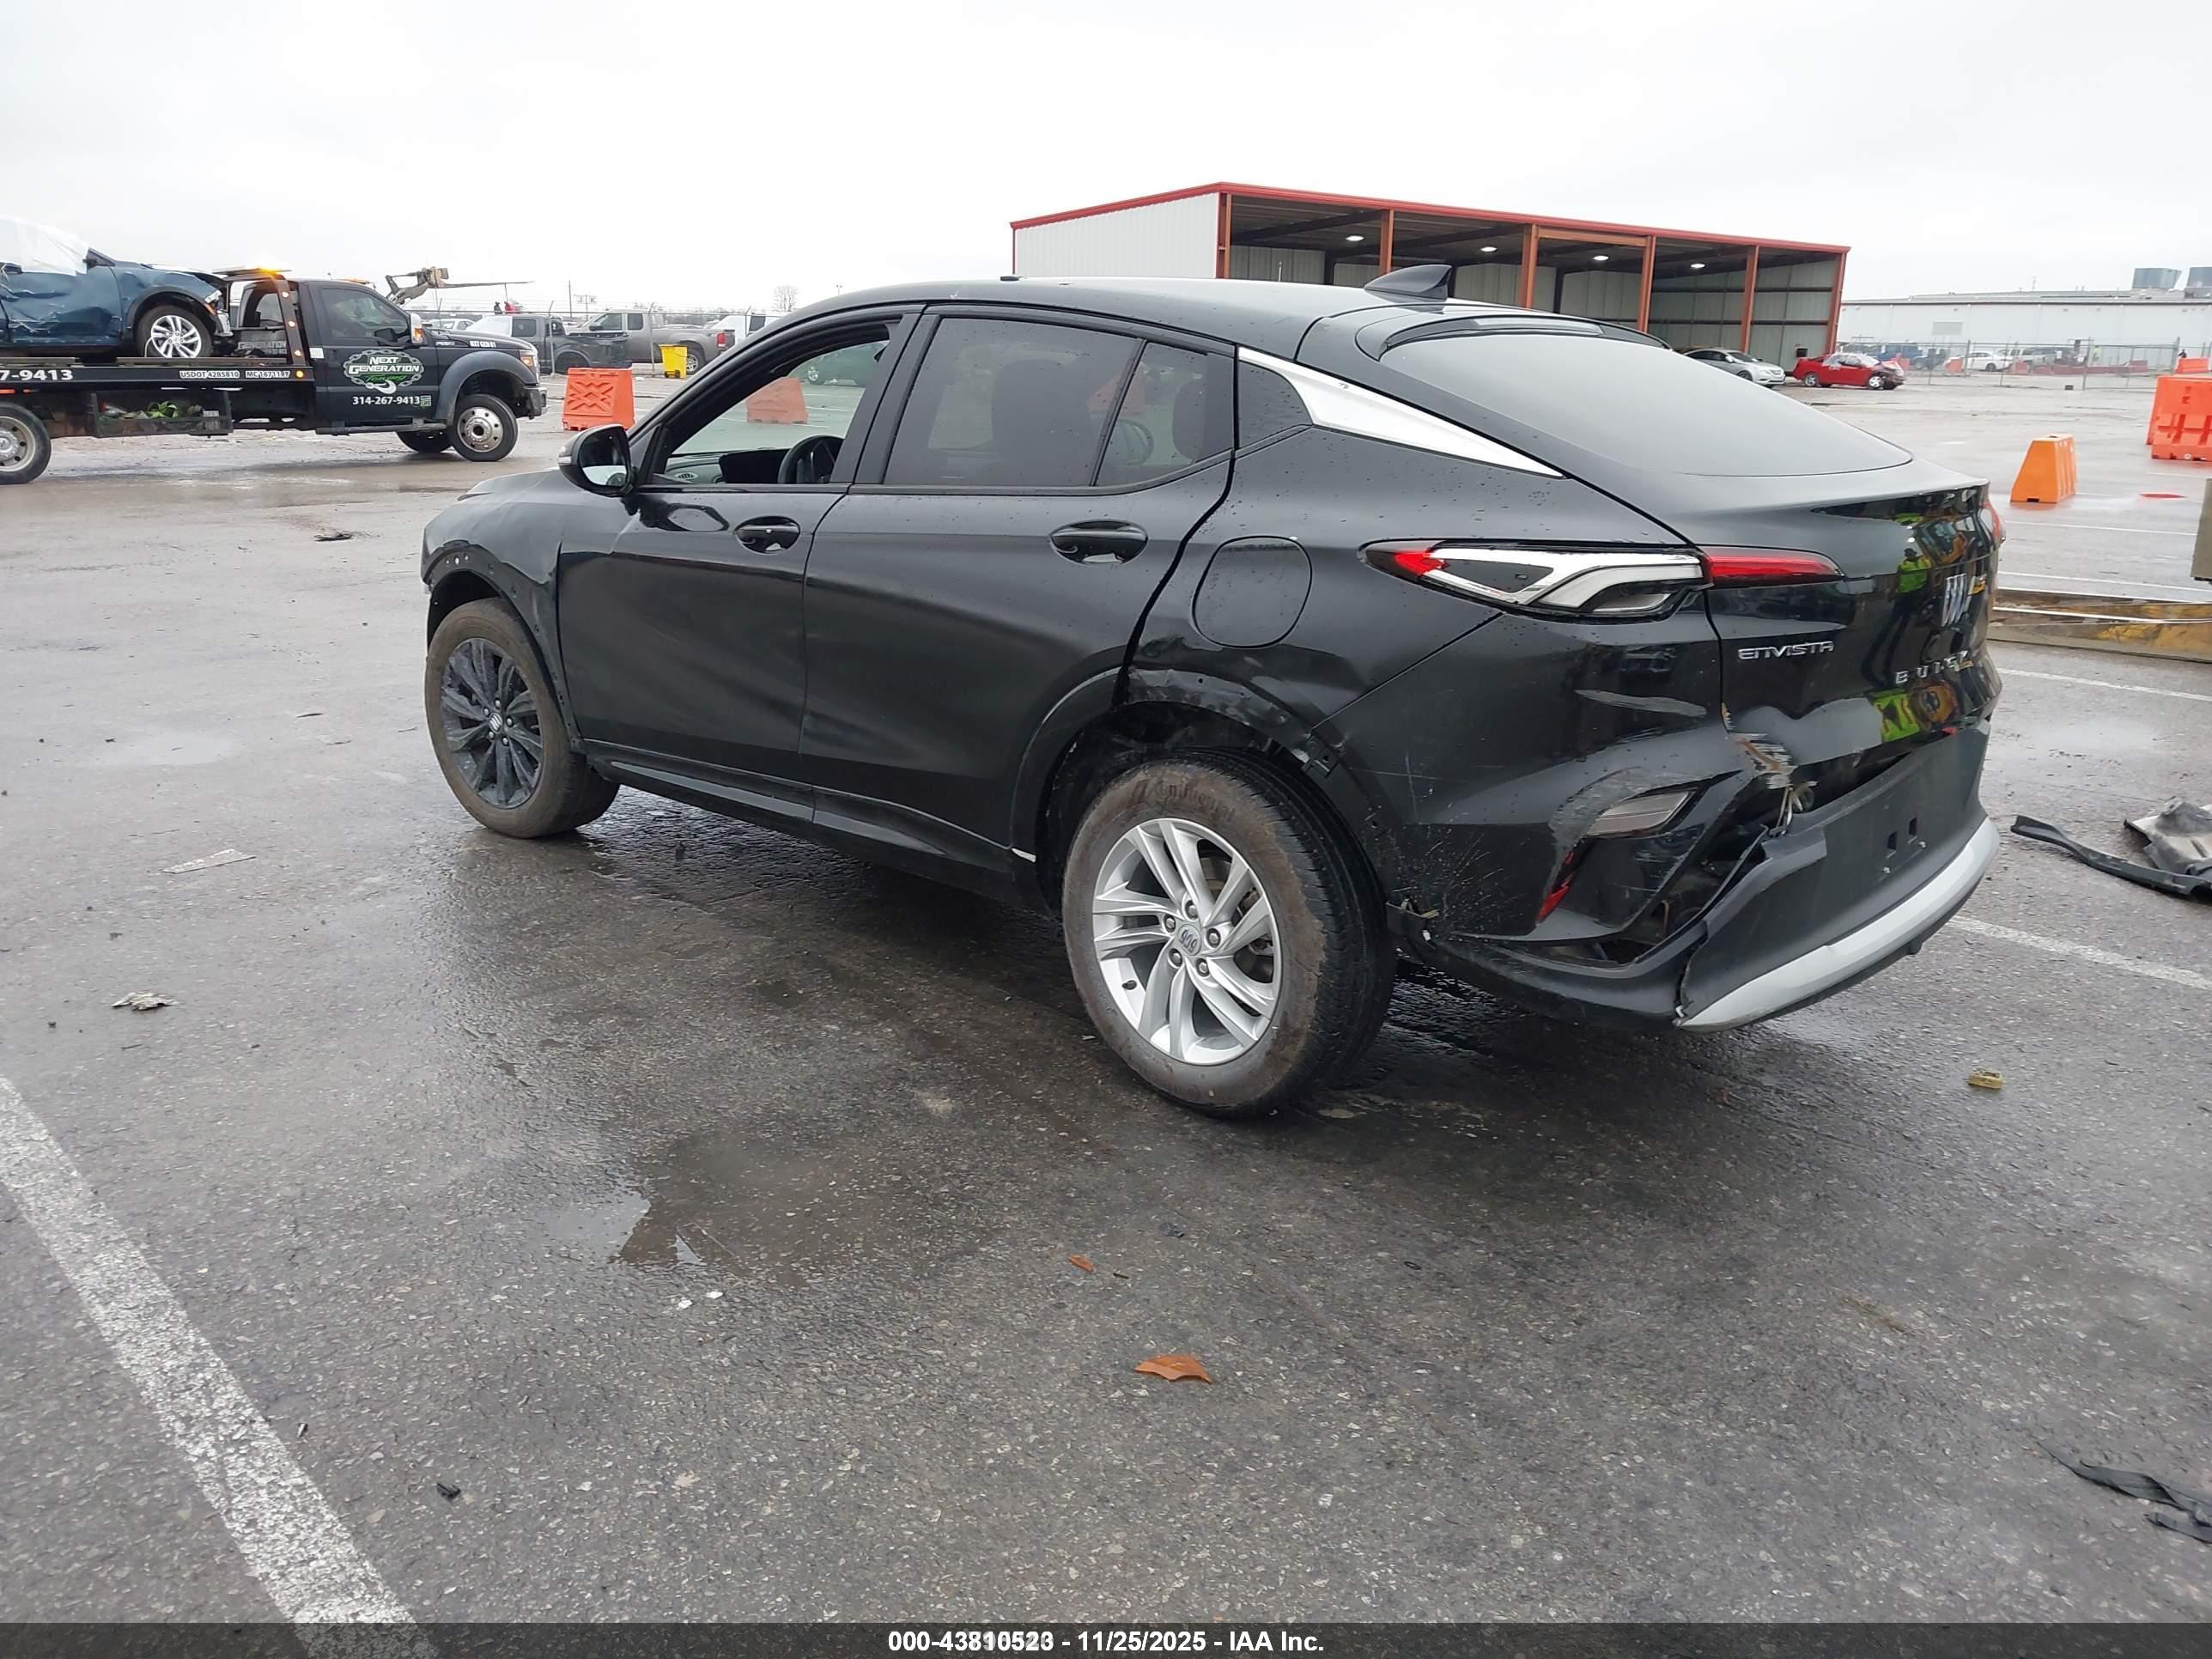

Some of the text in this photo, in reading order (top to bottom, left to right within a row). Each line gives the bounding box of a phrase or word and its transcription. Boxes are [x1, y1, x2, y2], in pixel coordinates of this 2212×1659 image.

[348, 365, 420, 374] GENERATION
[179, 370, 206, 379] USDOT
[352, 396, 421, 405] 314-267-9413
[1738, 641, 1835, 660] ENVISTA
